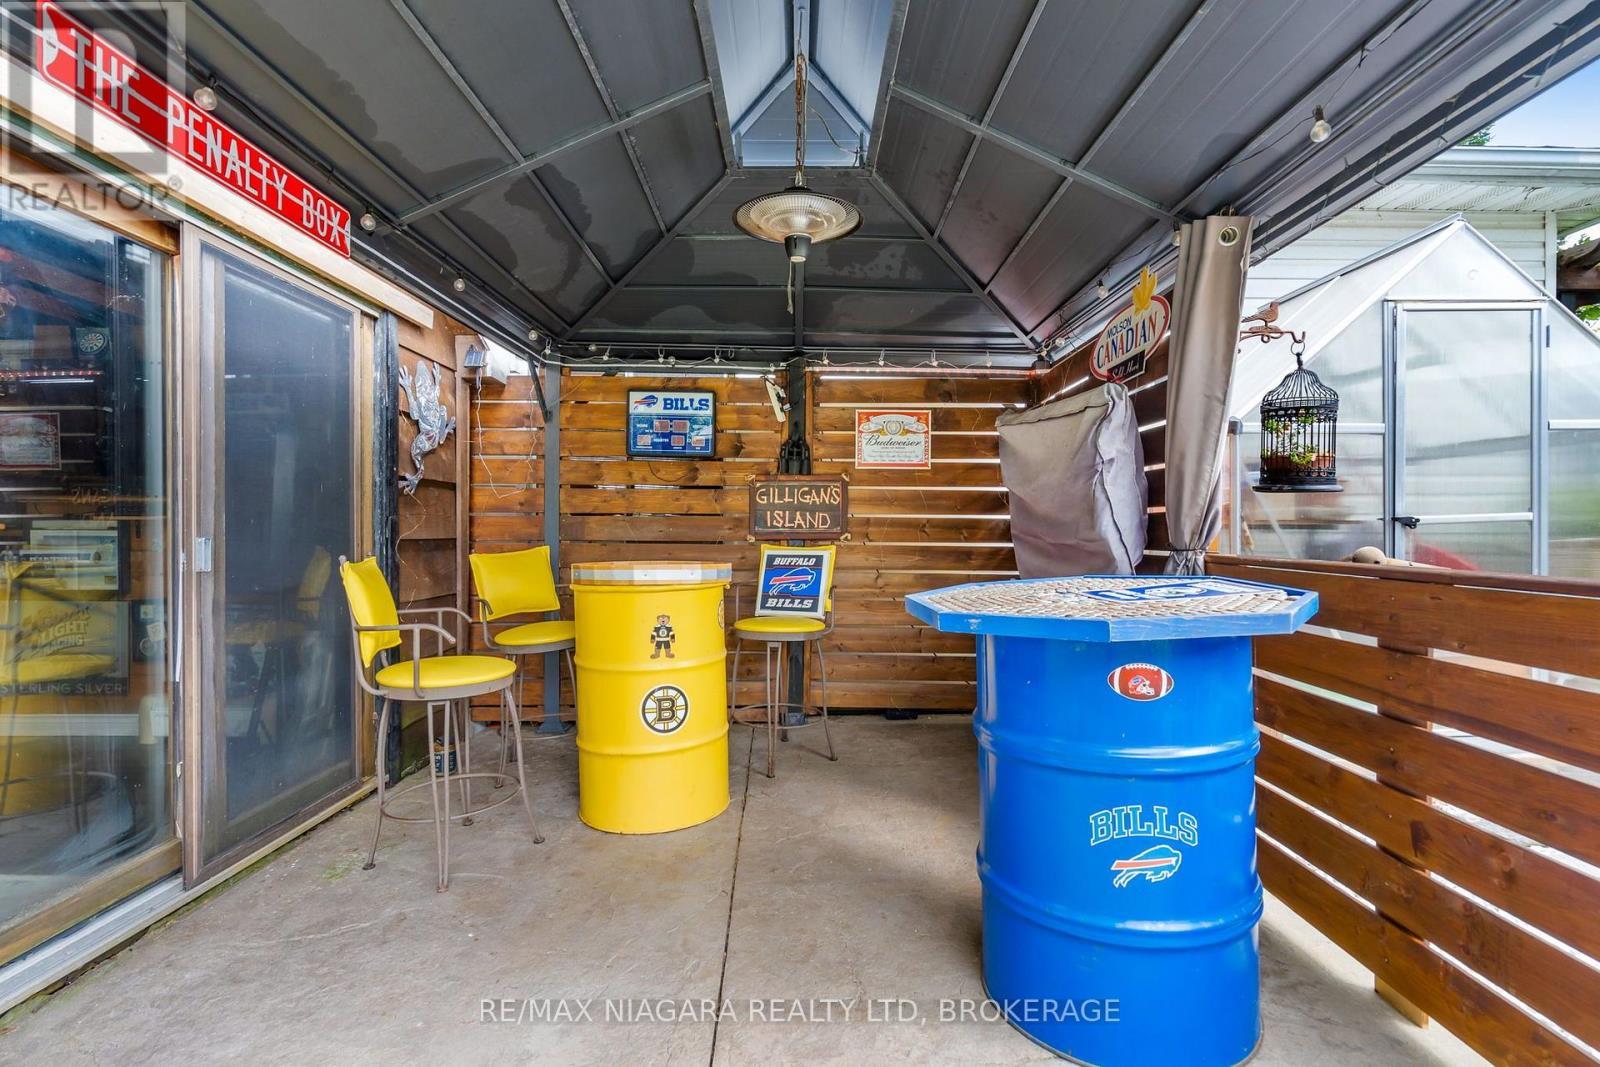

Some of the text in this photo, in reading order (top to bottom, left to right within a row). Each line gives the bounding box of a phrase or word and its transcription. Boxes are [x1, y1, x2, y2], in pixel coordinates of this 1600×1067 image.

[70, 28, 341, 247] THE PENALTY BOX
[1107, 316, 1132, 338] MOLSON
[1097, 312, 1158, 369] CANADIAN
[662, 397, 710, 411] BILLS
[864, 434, 921, 447] Budweiser
[756, 486, 841, 505] GILLIGAN'S
[766, 511, 831, 529] ISLAND
[773, 557, 816, 566] BUFFALO
[765, 598, 814, 608] BILLS
[76, 683, 122, 695] SILVER
[656, 698, 678, 723] B
[1090, 805, 1198, 846] BILLS
